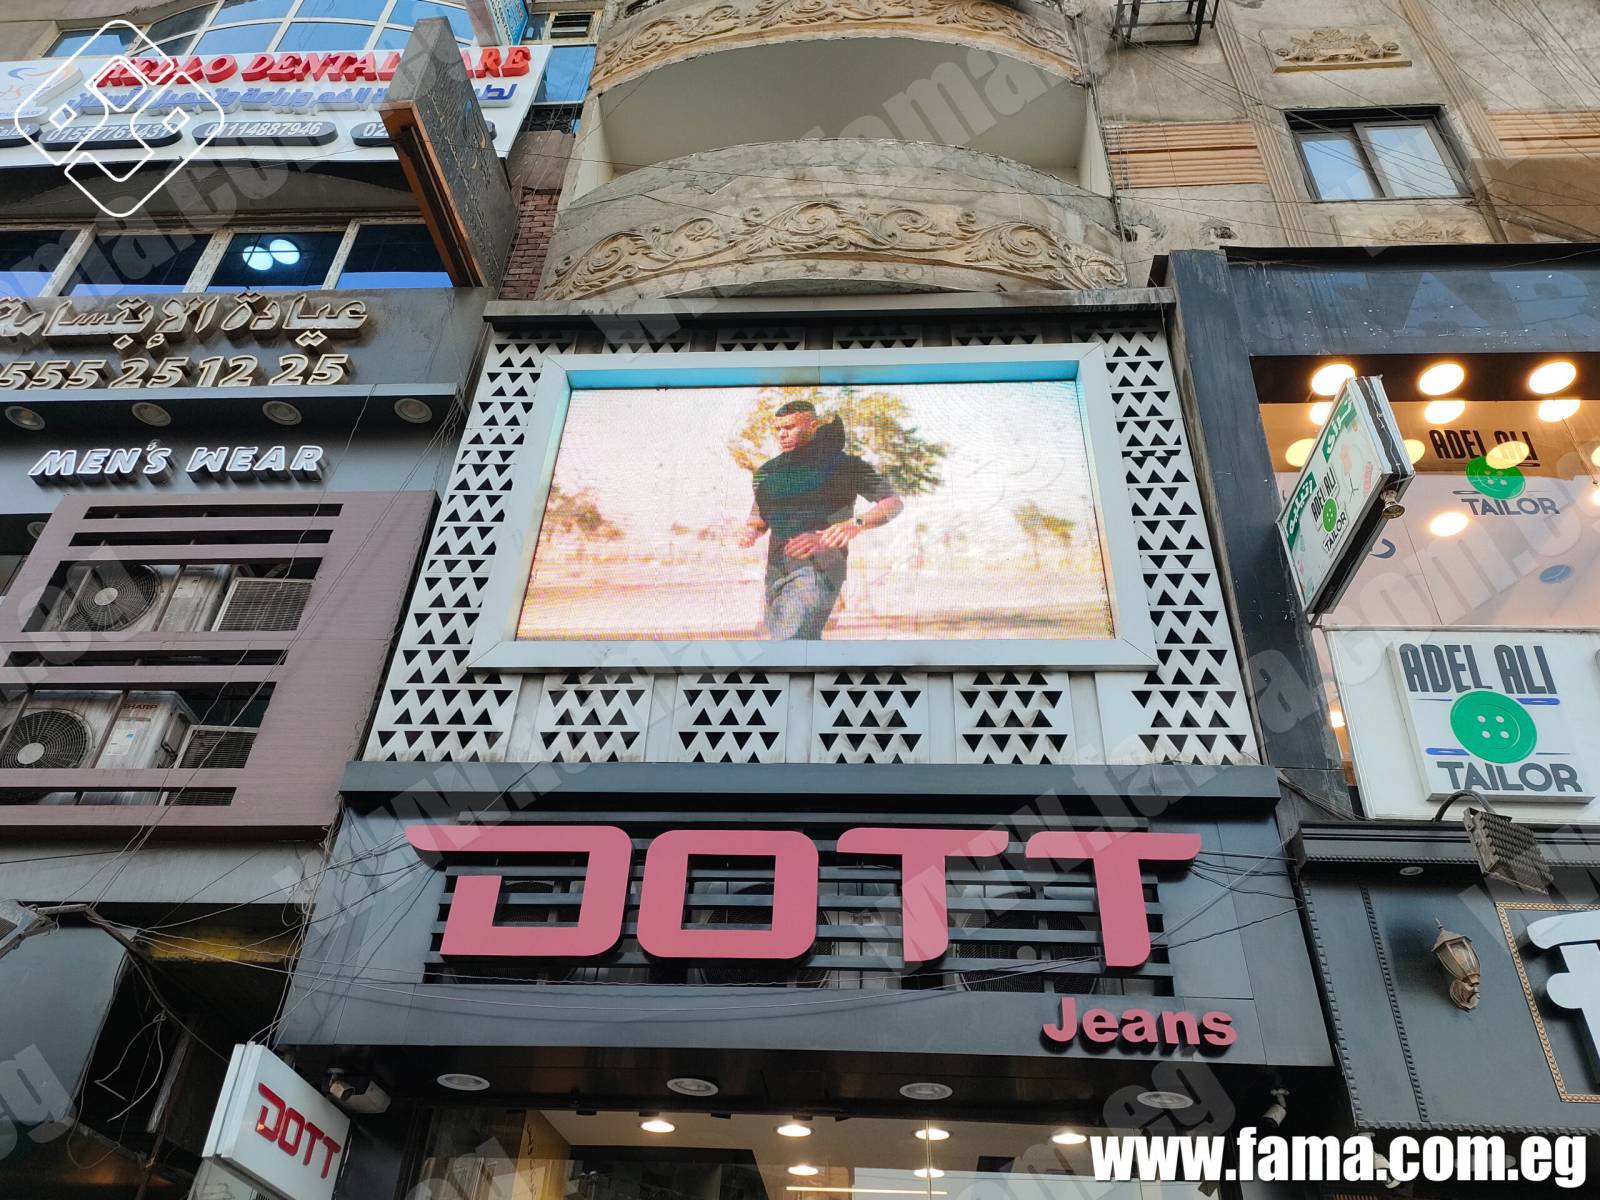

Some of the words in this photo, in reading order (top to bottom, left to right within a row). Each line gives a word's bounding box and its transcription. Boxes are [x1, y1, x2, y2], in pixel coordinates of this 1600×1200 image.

[241, 52, 401, 82] DENTAL
[204, 122, 323, 137] 01114887946
[108, 357, 191, 389] 25
[197, 355, 259, 388] 12
[268, 353, 349, 386] 25
[185, 445, 324, 473] WEAR
[1461, 498, 1561, 516] TAILOR
[1324, 510, 1348, 552] TAILOR
[1399, 643, 1493, 693] ADEL
[1493, 644, 1558, 695] ALI
[1436, 761, 1584, 793] TAILOR
[405, 825, 1202, 968] DOTT
[1042, 997, 1238, 1048] Jeans
[255, 1081, 342, 1180] DOTT
